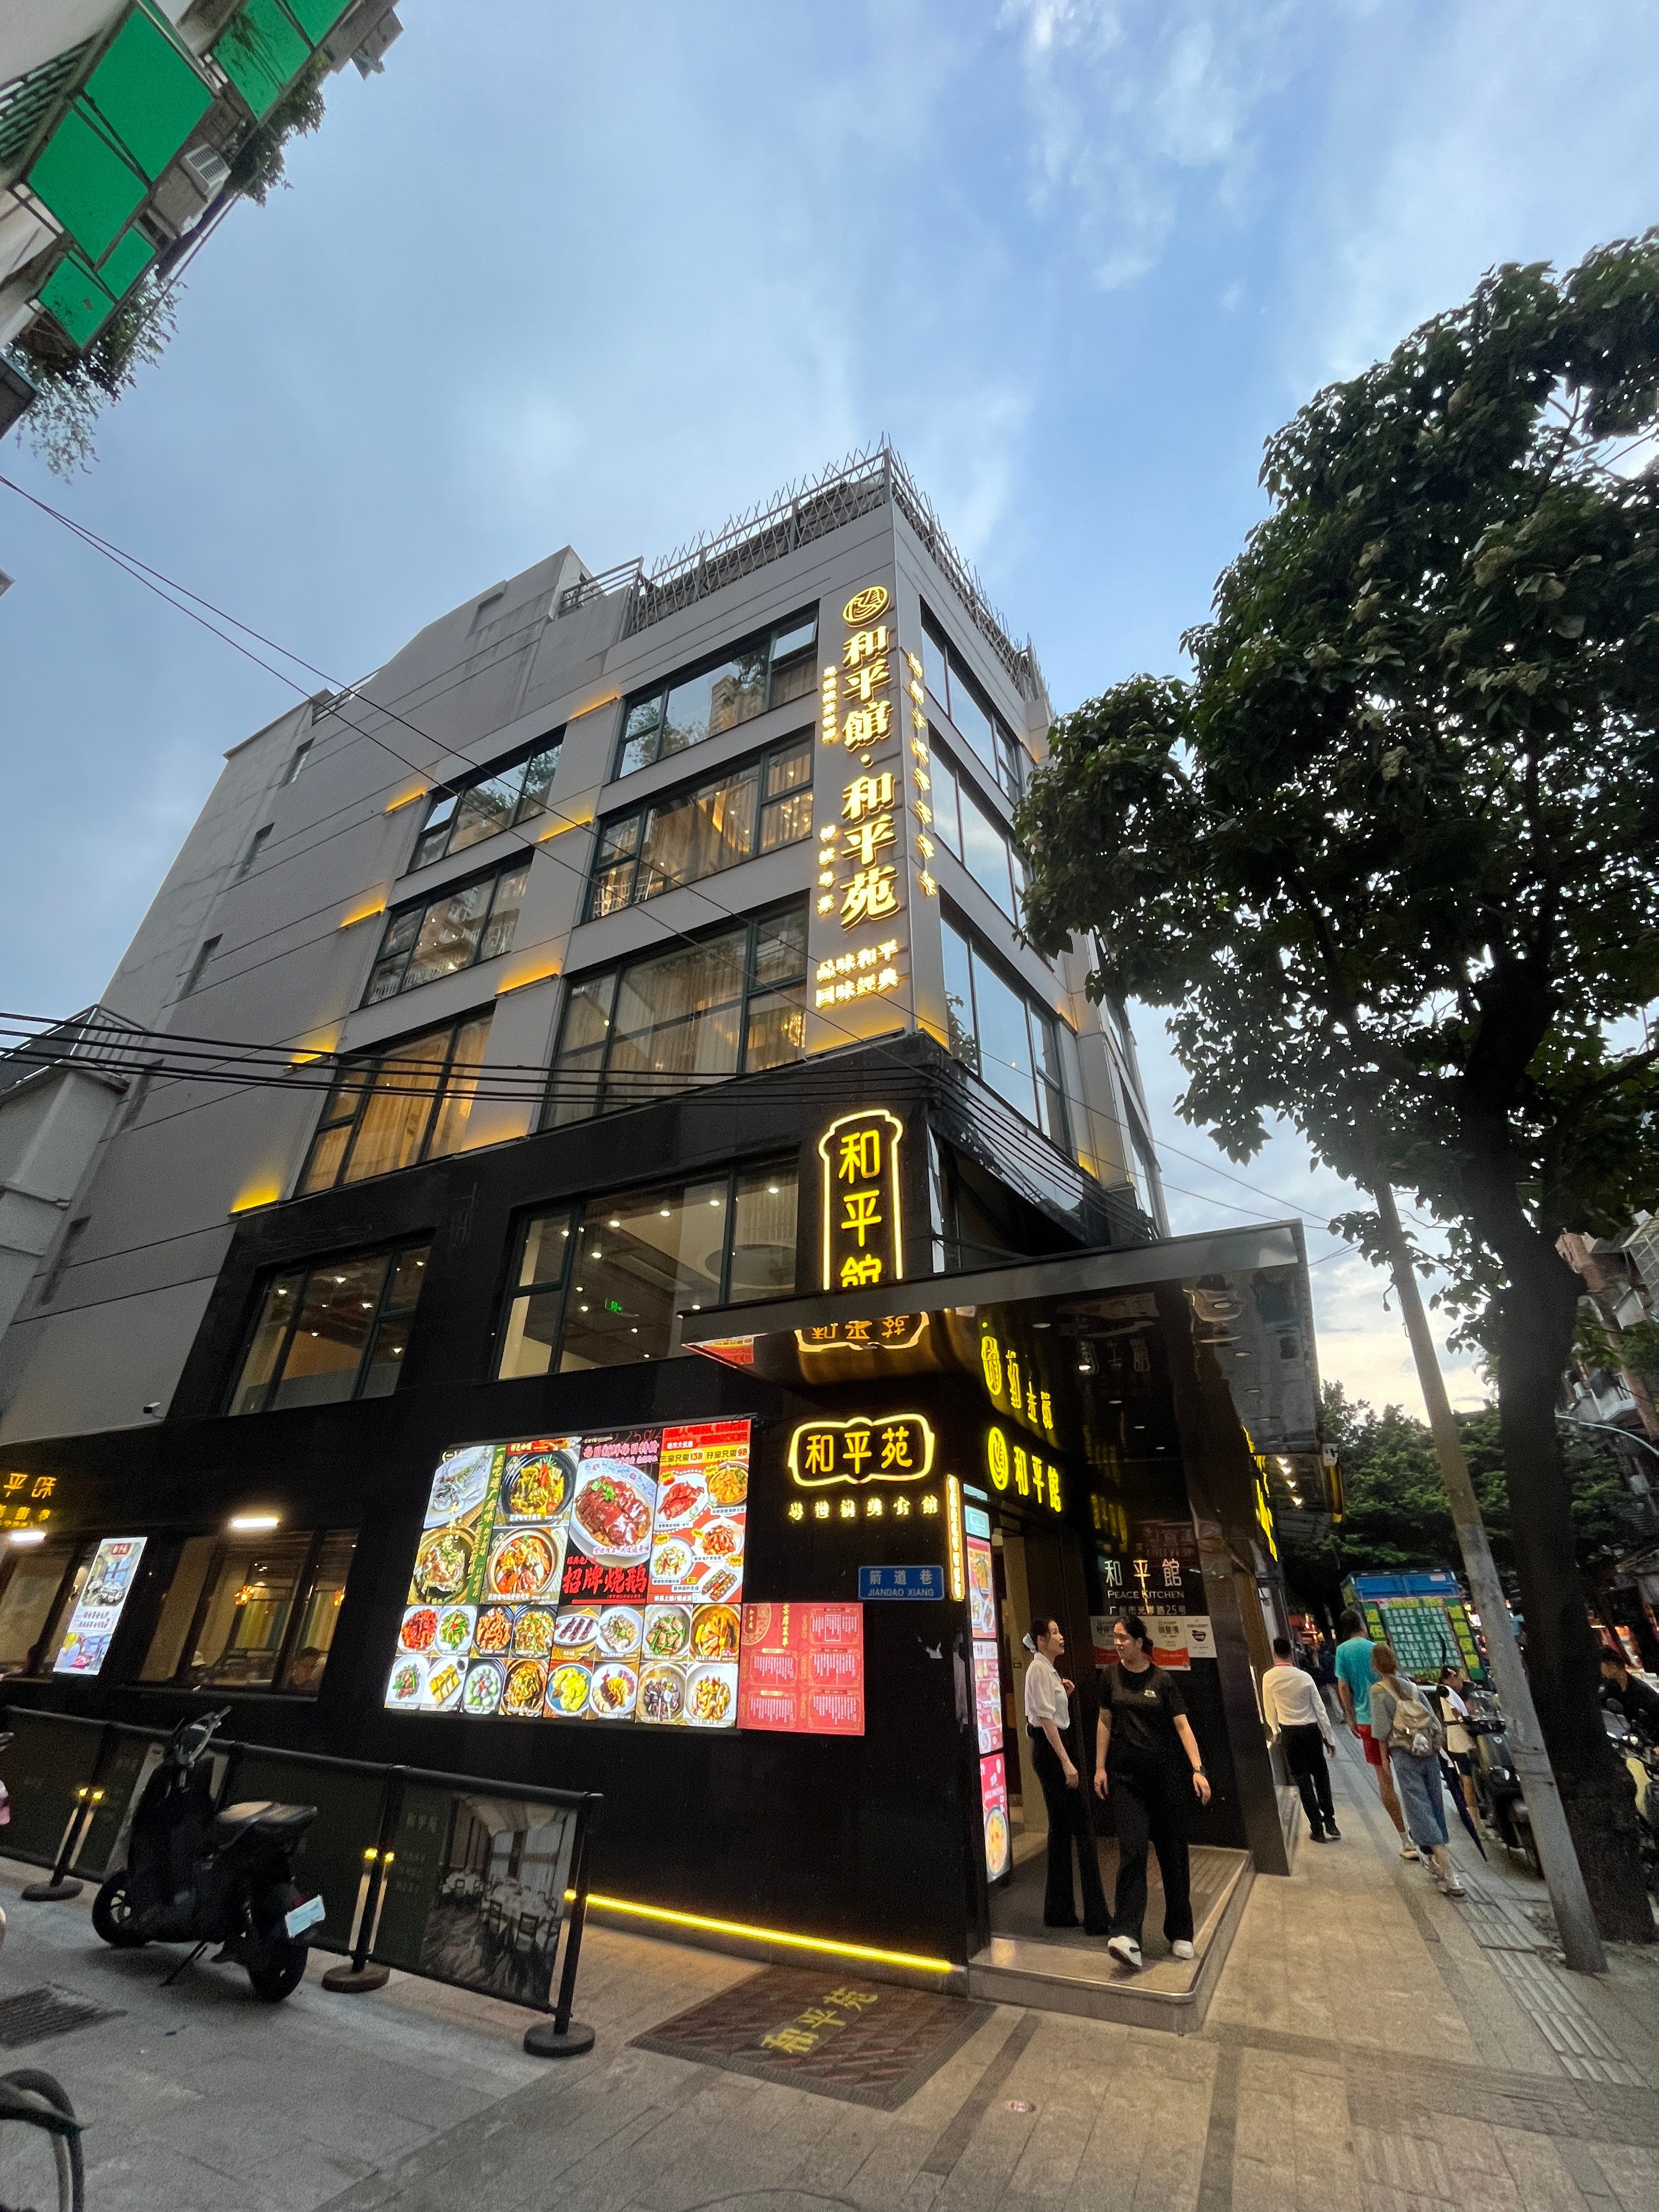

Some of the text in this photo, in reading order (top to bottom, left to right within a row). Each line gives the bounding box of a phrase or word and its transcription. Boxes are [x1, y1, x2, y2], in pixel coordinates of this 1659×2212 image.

[816, 939, 899, 982] 品味和平
[805, 1426, 913, 1474] 和平苑
[1014, 1446, 1061, 1512] 和平館
[562, 1565, 647, 1595] 招牌烧鹅
[870, 1569, 933, 1585] 箭道巷
[1104, 1558, 1182, 1587] 和平館
[868, 1588, 934, 1596] JIANDAO XIANG
[1108, 1590, 1184, 1599] PEACE KITCHEN
